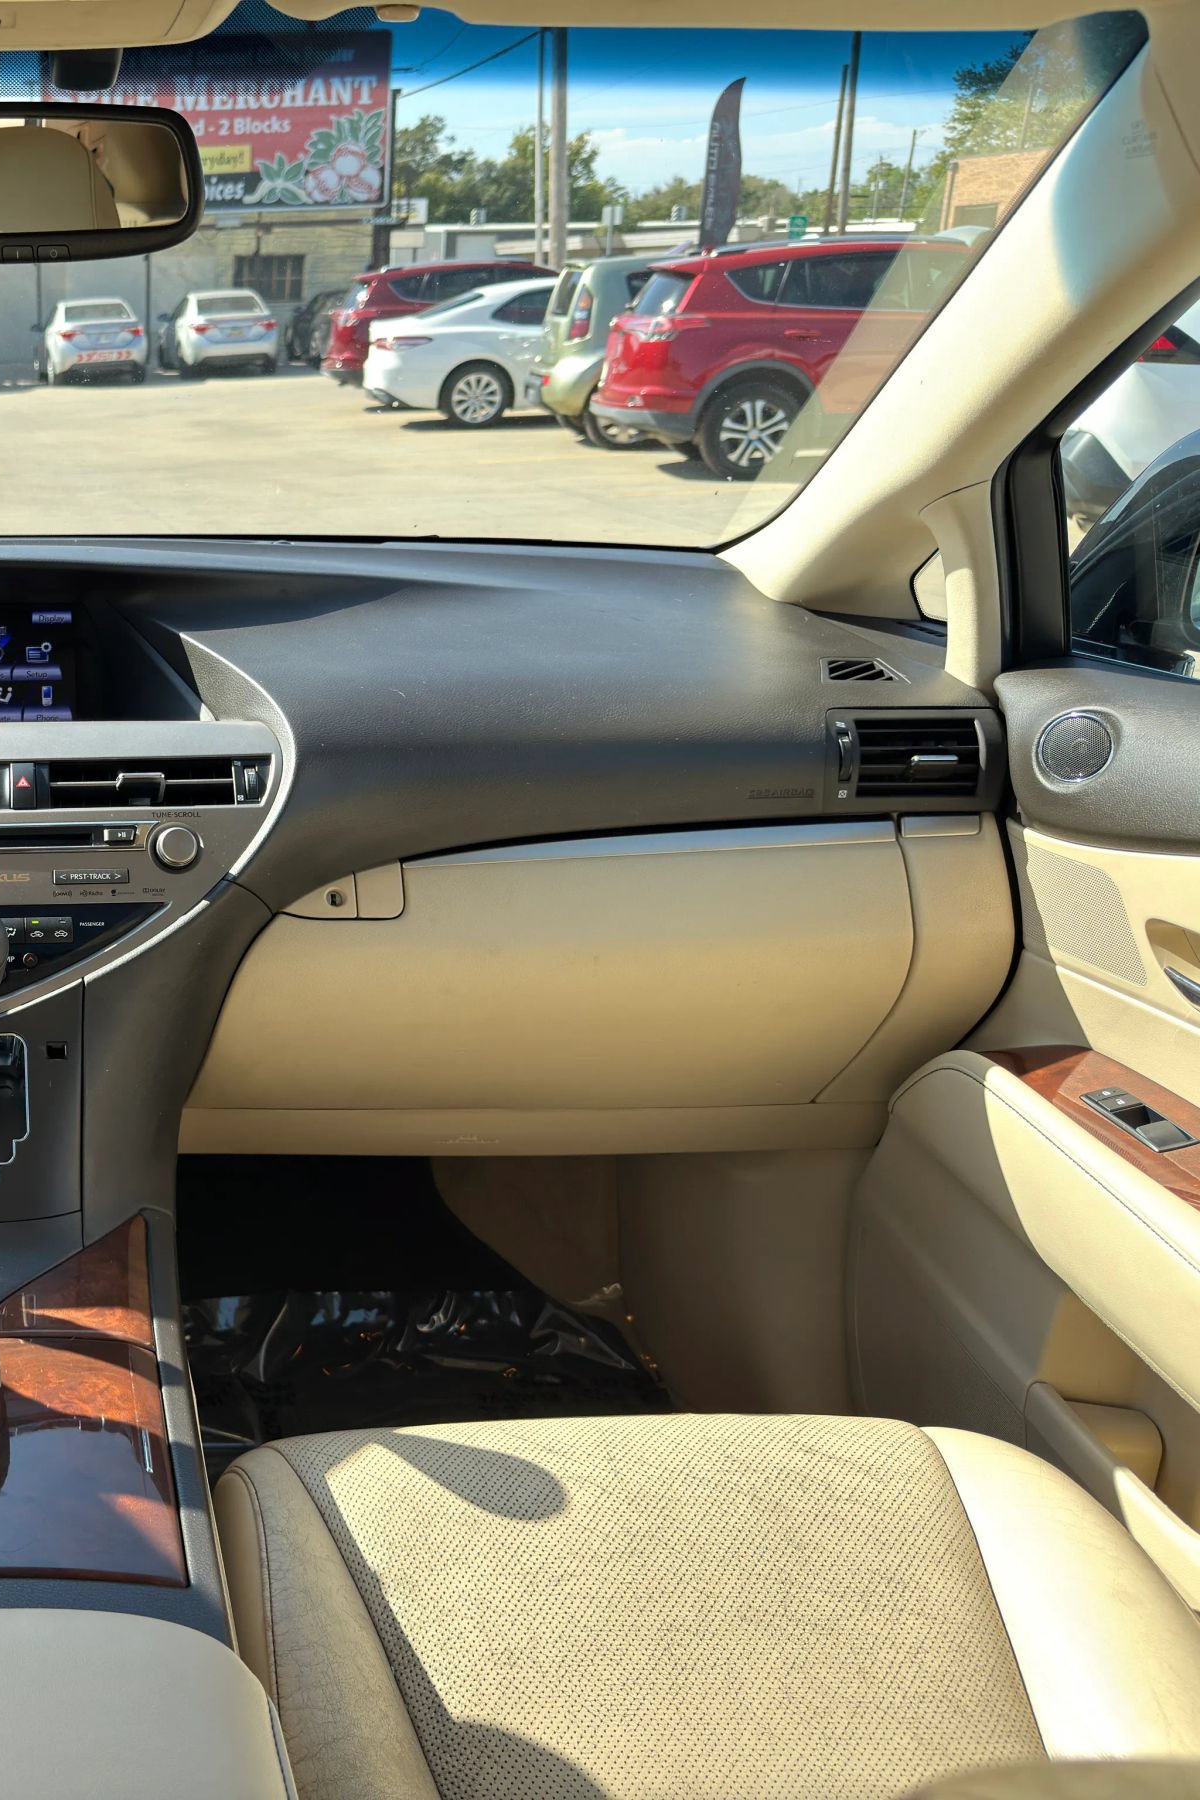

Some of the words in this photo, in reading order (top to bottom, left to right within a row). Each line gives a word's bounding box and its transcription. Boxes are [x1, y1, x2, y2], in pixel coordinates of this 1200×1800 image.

[173, 74, 378, 112] MERCHANT
[218, 118, 230, 136] 2
[233, 115, 292, 135] Blocks
[38, 614, 65, 625] Display
[26, 670, 48, 680] Setup
[36, 713, 59, 721] Phone
[70, 872, 111, 880] PRST-TRACK
